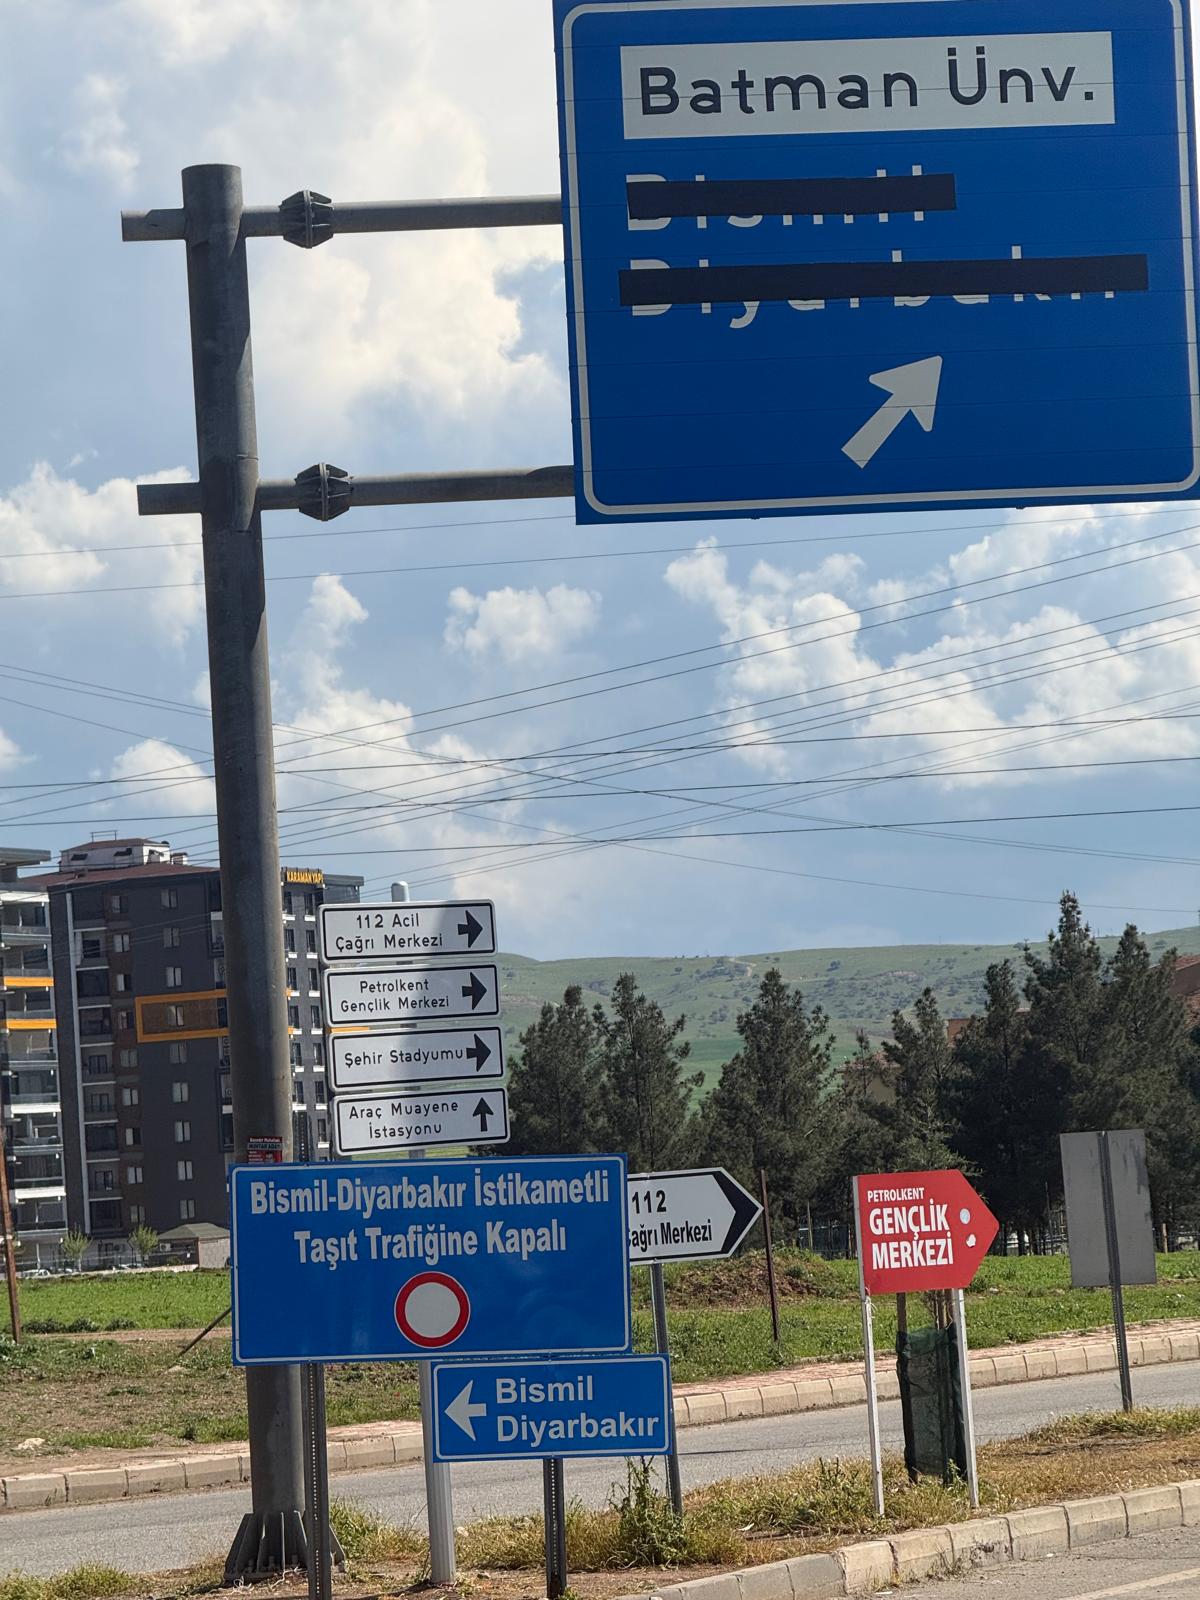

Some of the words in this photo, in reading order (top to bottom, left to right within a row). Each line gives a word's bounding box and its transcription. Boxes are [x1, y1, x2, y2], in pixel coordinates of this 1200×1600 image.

[639, 65, 918, 115] Batman
[947, 46, 1094, 106] Ünv.
[356, 914, 384, 929] 112
[392, 912, 420, 928] Acil
[335, 936, 374, 953] Çağrı
[384, 933, 443, 949] Merkezi
[360, 978, 429, 993] Petrolkent
[340, 1001, 391, 1014] Gençlik
[398, 996, 449, 1010] Merkezi
[344, 1052, 383, 1068] Şehir
[390, 1049, 464, 1065] Stadyumu
[349, 1106, 382, 1120] Araç
[391, 1101, 459, 1118] Muayene
[369, 1123, 442, 1140] İstasyonu
[250, 1175, 466, 1219] Bismil-Diyarbakır
[474, 1168, 609, 1207] İstikametli
[632, 1190, 667, 1214] 112
[867, 1187, 925, 1203] PETROLKENT
[869, 1198, 950, 1241] GENÇLİK
[294, 1230, 359, 1270] Taşıt
[363, 1224, 477, 1265] Trafiğine
[486, 1219, 567, 1261] Kapalı
[629, 1224, 658, 1252] ağrı
[660, 1219, 712, 1245] Merkezi
[872, 1231, 954, 1270] MERKEZİ
[496, 1375, 594, 1404] Bismil
[496, 1412, 660, 1448] Diyarbakır
